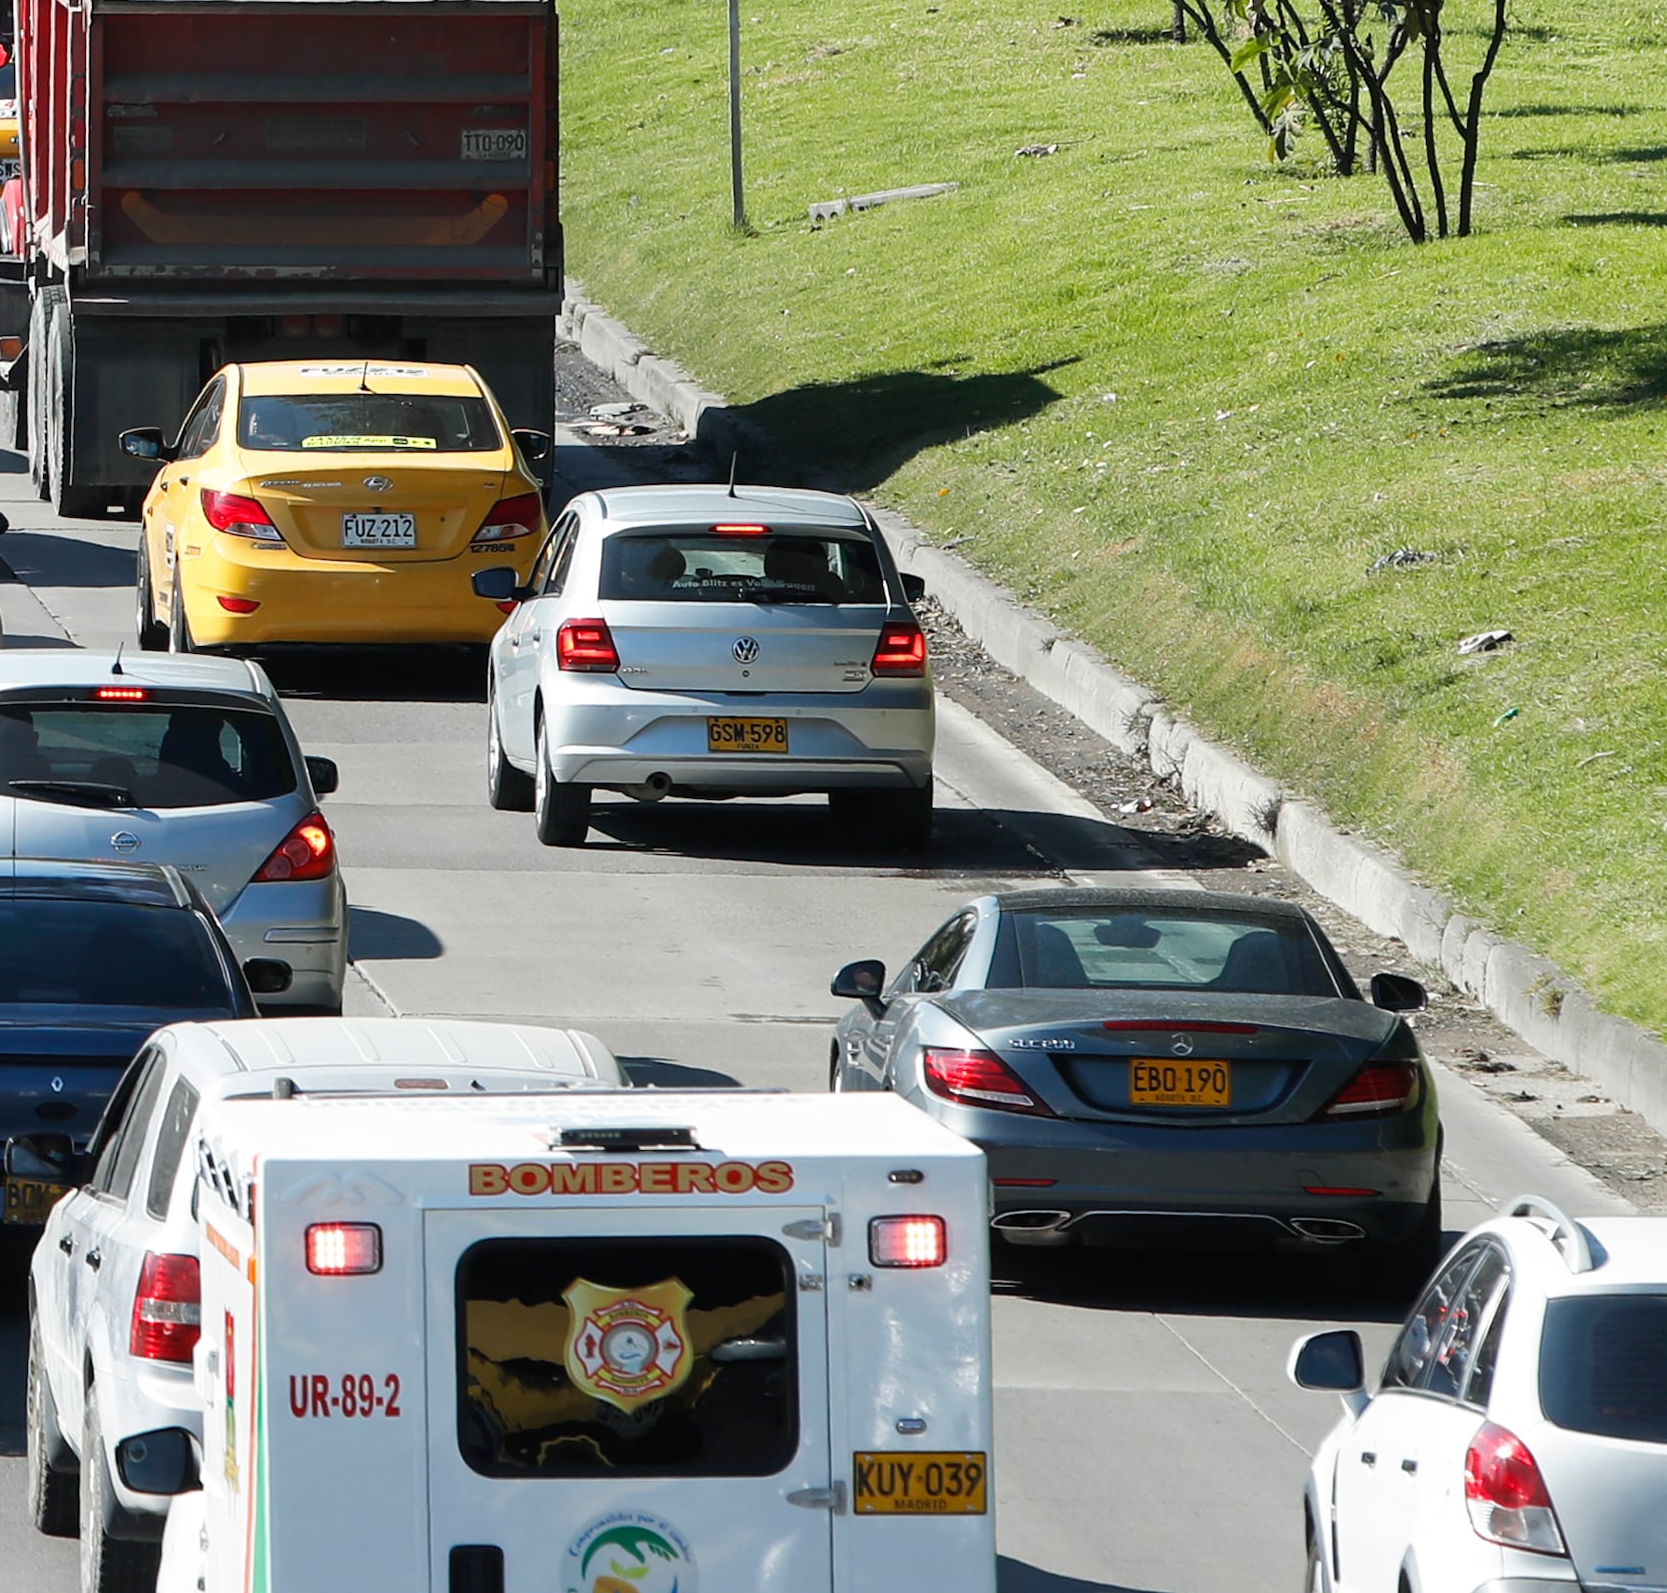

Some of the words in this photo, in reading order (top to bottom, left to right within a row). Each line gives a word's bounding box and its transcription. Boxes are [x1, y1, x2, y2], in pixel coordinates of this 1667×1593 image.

[672, 580, 700, 588] Auto
[469, 1160, 794, 1195] BOMBEROS
[289, 1373, 402, 1419] UR-89-2
[894, 1499, 947, 1511] MADRID
